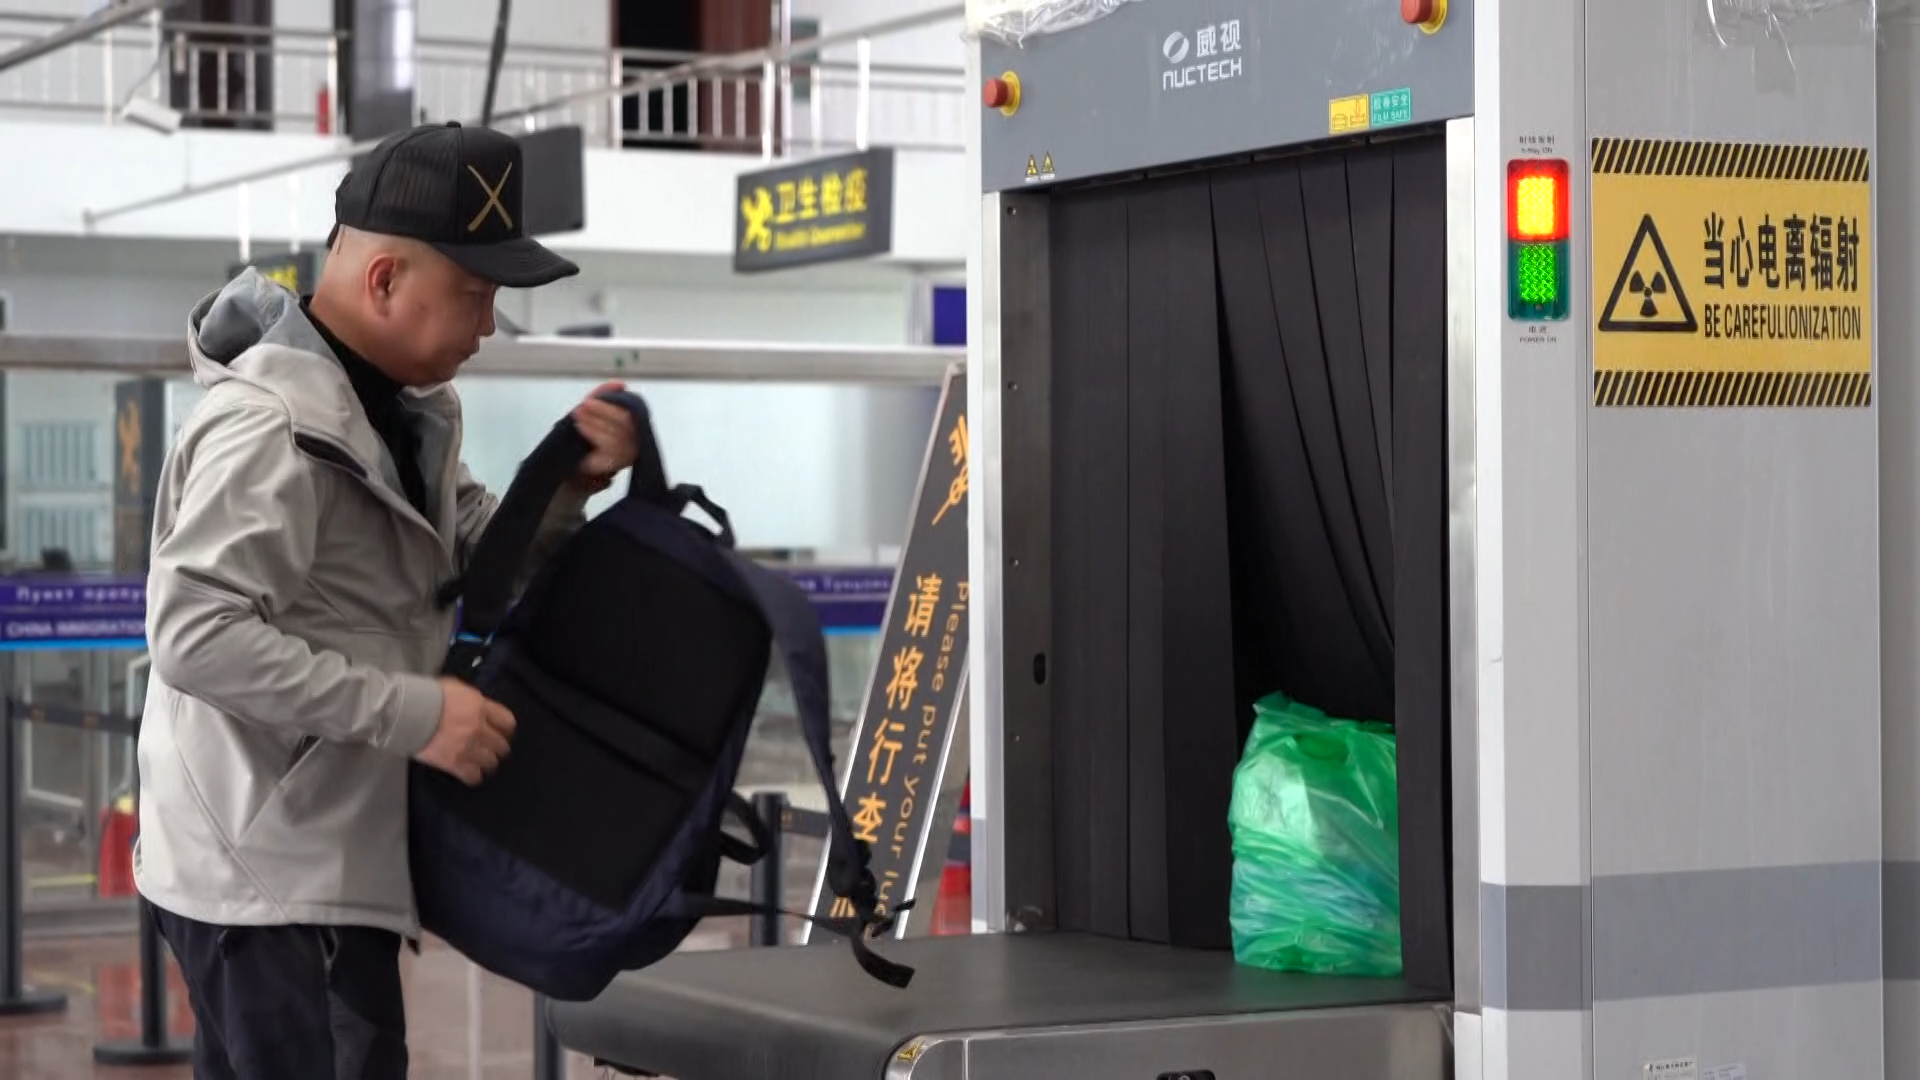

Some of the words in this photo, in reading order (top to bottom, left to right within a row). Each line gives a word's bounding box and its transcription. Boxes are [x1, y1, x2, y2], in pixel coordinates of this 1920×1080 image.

[1196, 19, 1241, 58] 威视
[1703, 211, 1860, 292] 当心电离辐射
[1704, 303, 1721, 338] BE
[1724, 303, 1861, 340] CAREFULIONIZATION
[912, 704, 936, 765] put
[890, 774, 920, 860] your
